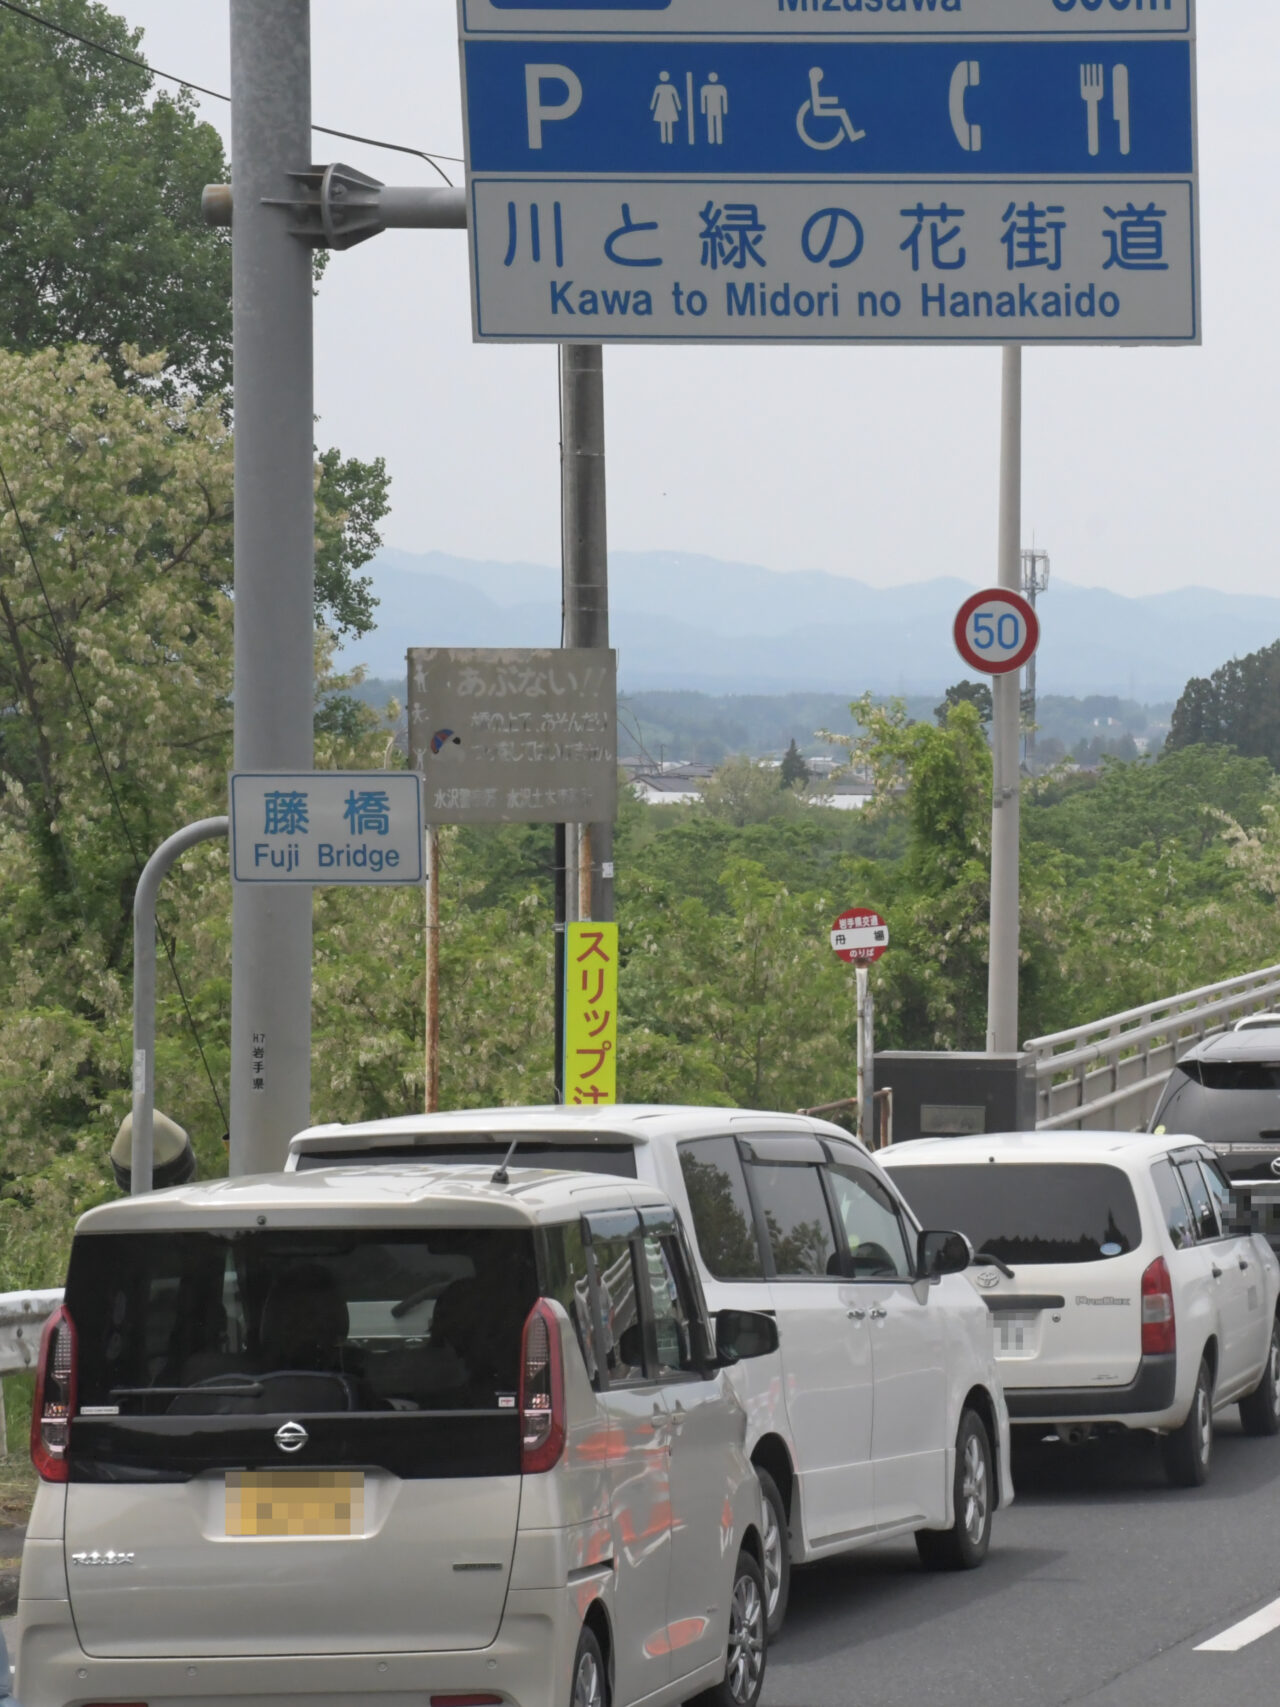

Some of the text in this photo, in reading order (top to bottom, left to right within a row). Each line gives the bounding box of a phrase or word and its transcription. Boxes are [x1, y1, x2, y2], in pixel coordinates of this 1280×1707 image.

[524, 62, 583, 149] P
[503, 200, 1170, 272] 川と緑の花街道
[549, 281, 1120, 317] Kawa to Midori no Hanakaido
[972, 613, 1020, 650] 50
[263, 789, 391, 836] 藤橋
[254, 843, 400, 872] Fuji Bridge
[848, 947, 875, 958] のりば
[252, 1046, 265, 1090] 岩手県
